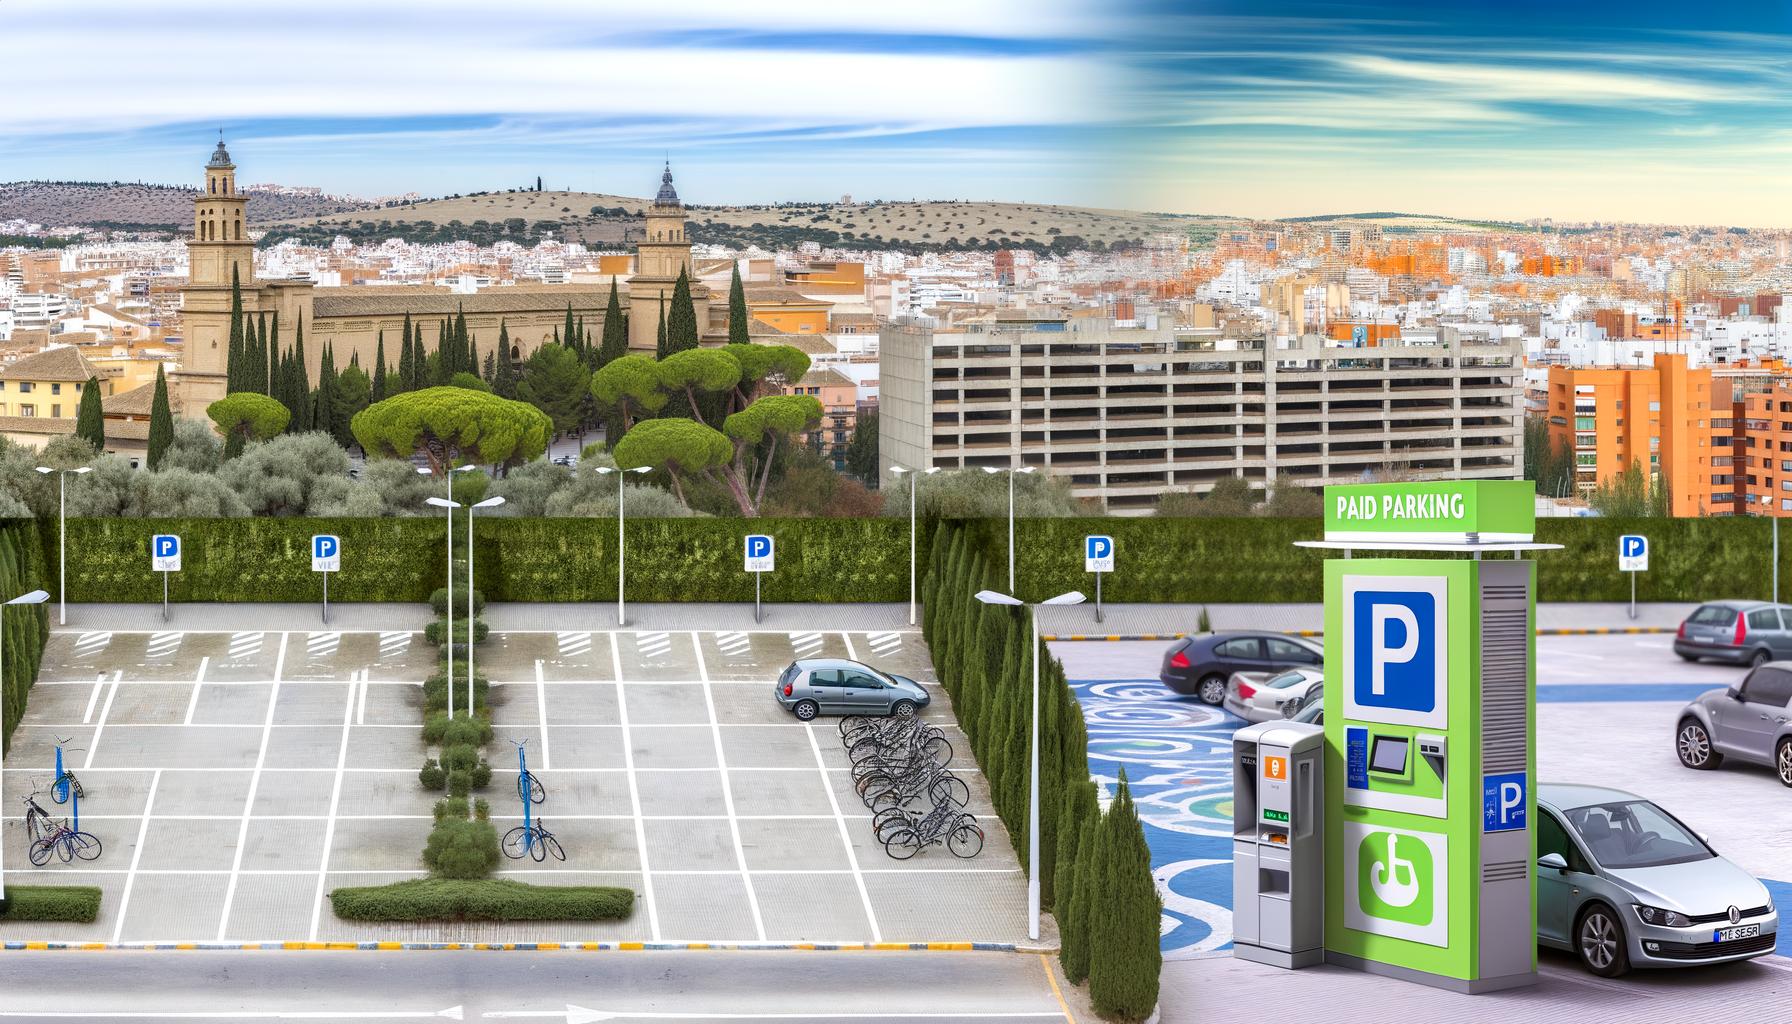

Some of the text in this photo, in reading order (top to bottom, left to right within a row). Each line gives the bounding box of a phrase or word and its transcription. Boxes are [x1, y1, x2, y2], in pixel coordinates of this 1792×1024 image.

[1337, 493, 1465, 520] PAID PARKING
[162, 541, 173, 555] P
[321, 541, 332, 557] P
[754, 541, 765, 557] P
[1095, 541, 1106, 558] P
[1372, 603, 1420, 695] P
[1500, 782, 1522, 824] P
